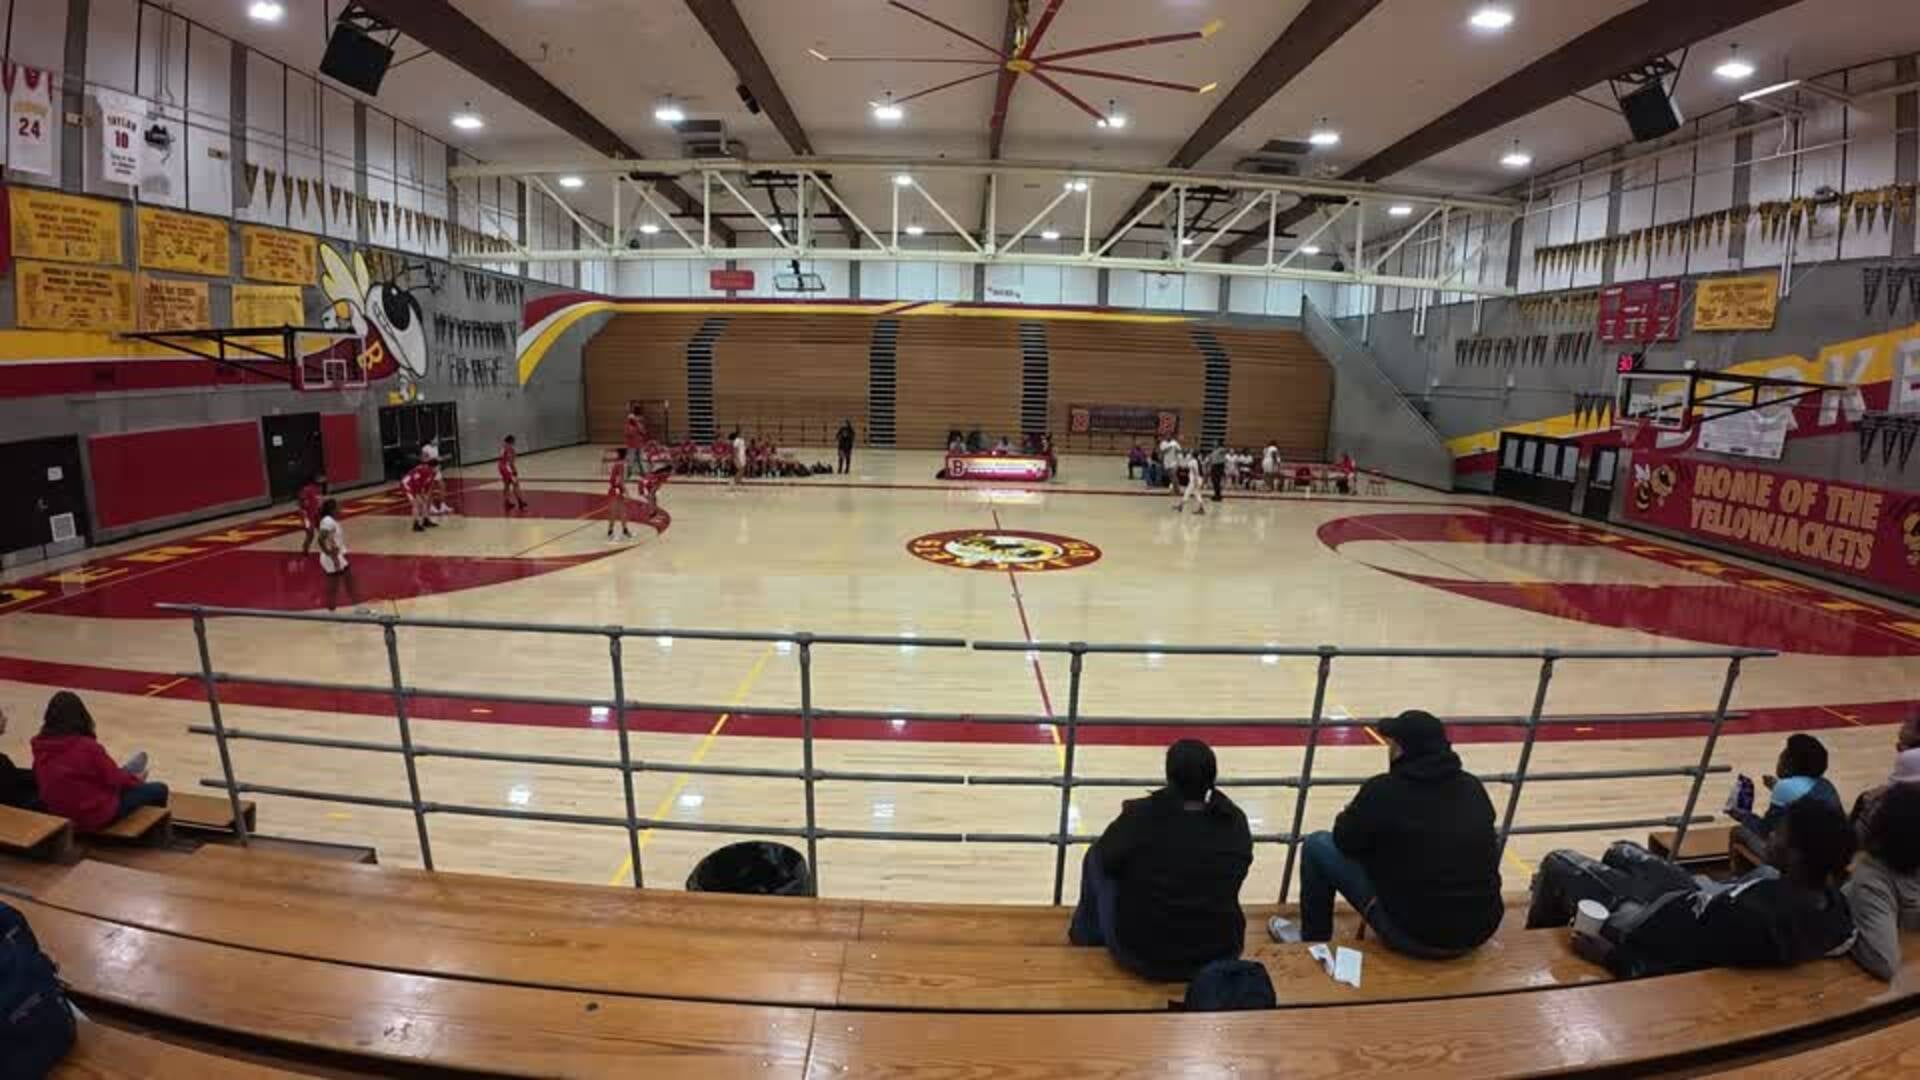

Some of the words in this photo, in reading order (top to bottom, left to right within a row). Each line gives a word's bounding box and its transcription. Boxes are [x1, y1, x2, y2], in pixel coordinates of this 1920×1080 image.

[18, 117, 41, 140] 24
[115, 130, 129, 149] 10
[1694, 463, 1774, 508] HOME
[1779, 478, 1820, 516] OF
[1827, 489, 1884, 529] THE
[1690, 497, 1877, 570] YELLOWJACKETS
